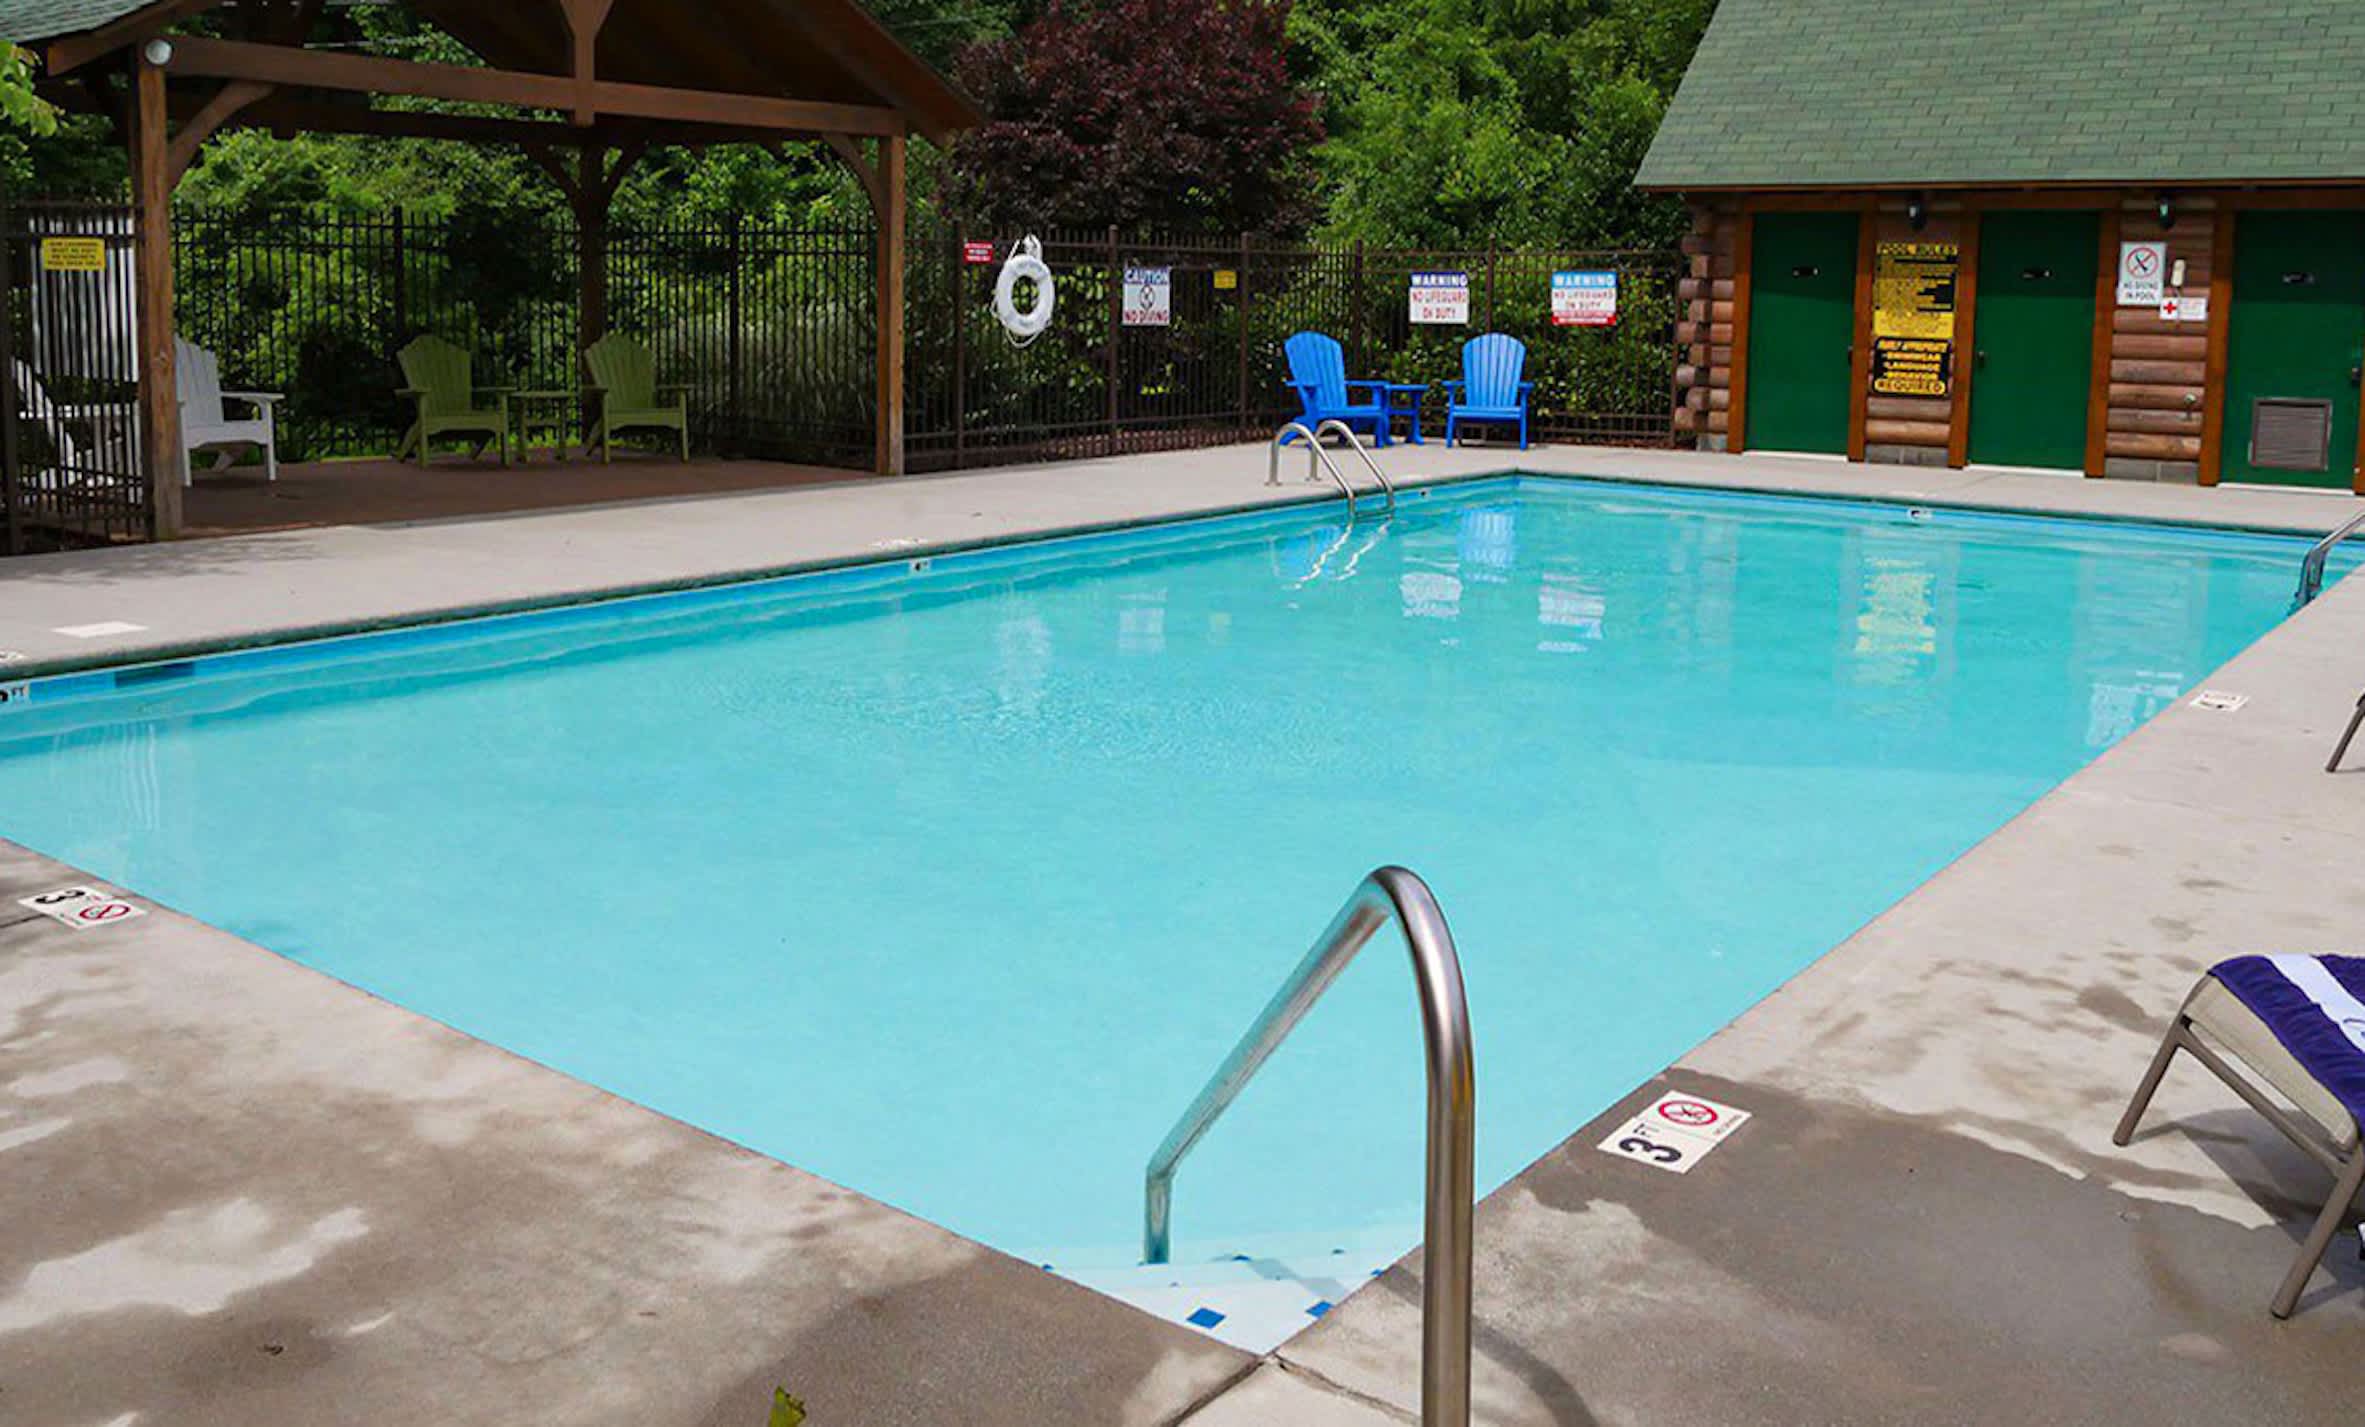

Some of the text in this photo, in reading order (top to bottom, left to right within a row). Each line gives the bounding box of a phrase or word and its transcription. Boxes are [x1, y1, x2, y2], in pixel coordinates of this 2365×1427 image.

[1876, 243, 1958, 257] POOL RULES
[1124, 268, 1168, 284] CAUTION
[1411, 274, 1468, 287] WARNING
[1553, 274, 1615, 287] WARNING
[2123, 281, 2159, 291] NO DIVING
[1413, 290, 1467, 303] NO LIFEGUARD
[1554, 291, 1614, 300] NO LIFEGUARD
[2124, 291, 2155, 301] IN POOL
[1567, 302, 1602, 310] ON DUTY
[1125, 310, 1168, 323] NO DIVING
[1423, 307, 1456, 319] ON DUTY
[1887, 361, 1940, 372] LANGUAGE
[1877, 379, 1944, 393] REQUIRED
[35, 889, 85, 904] 3
[1618, 1137, 1682, 1163] 3
